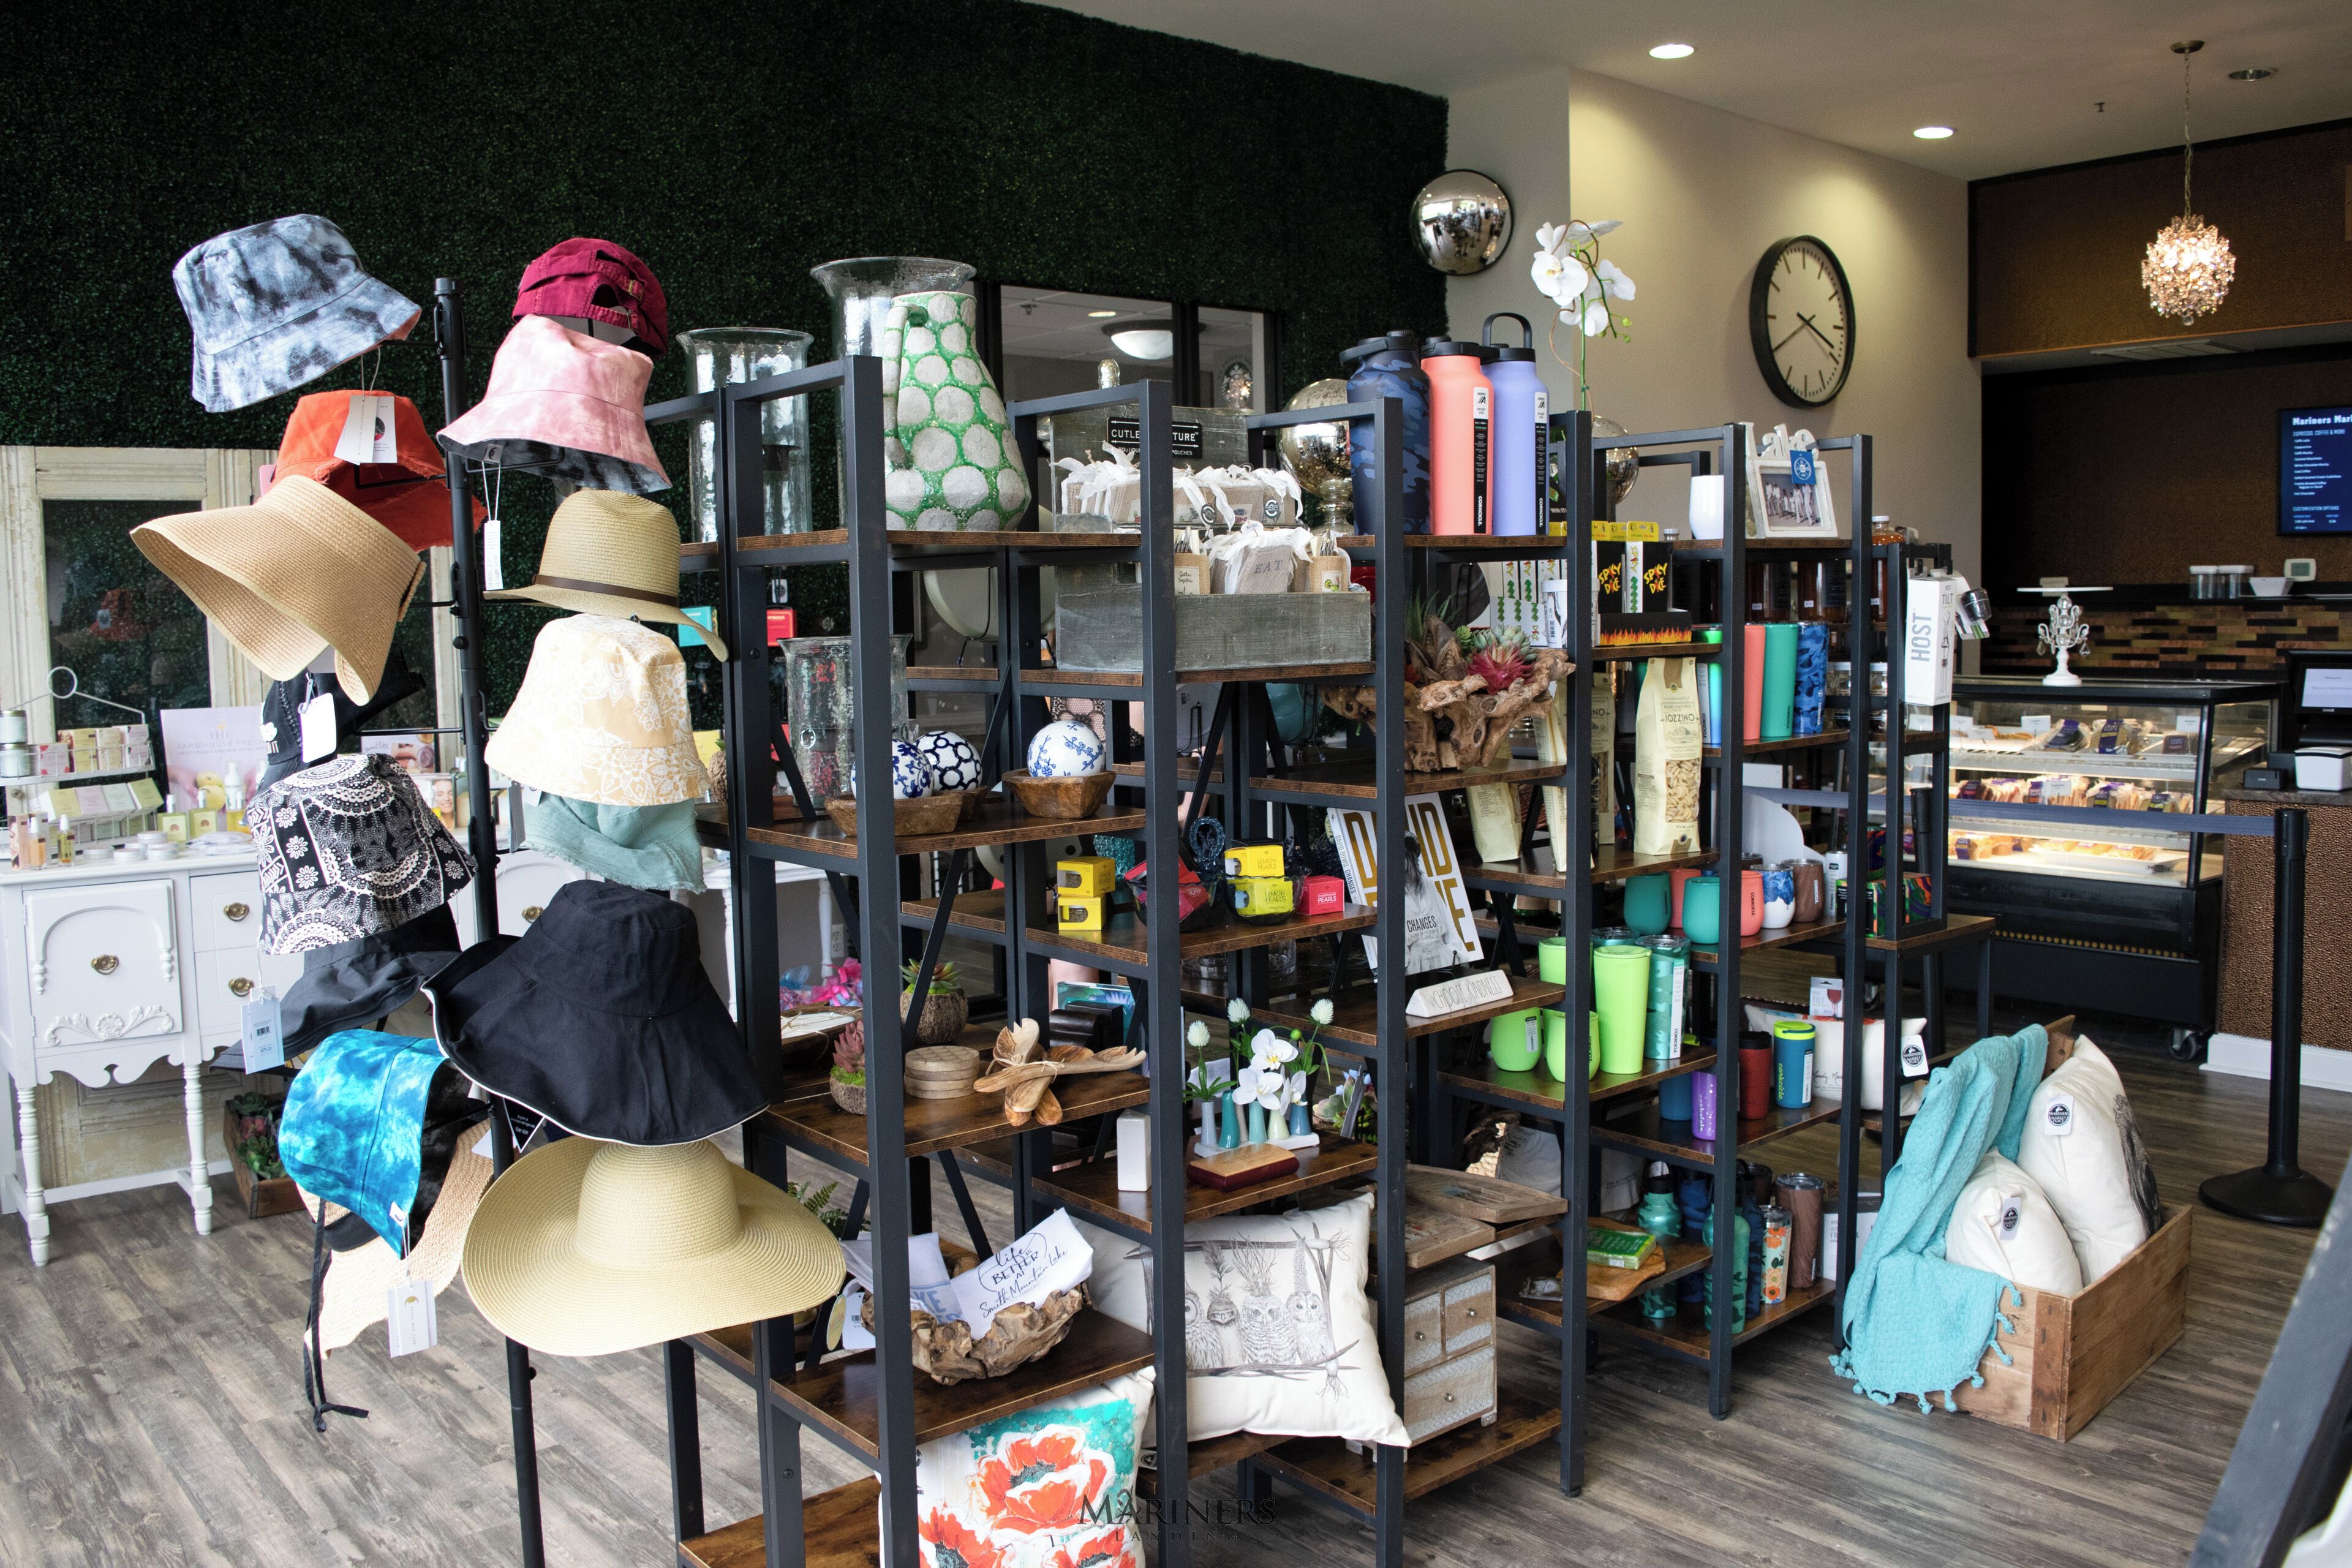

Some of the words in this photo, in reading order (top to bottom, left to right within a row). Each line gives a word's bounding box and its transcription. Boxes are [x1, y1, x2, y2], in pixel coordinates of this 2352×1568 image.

[2293, 417, 2331, 426] Mariners
[1253, 560, 1284, 575] EAT
[1942, 593, 1953, 606] TILT
[1910, 612, 1932, 662] HOST
[1665, 714, 1695, 722] IOZZINO
[177, 741, 232, 750] FARMHOUSE
[1335, 834, 1344, 851] DAVID
[1344, 869, 1357, 894] CHANGES
[1406, 915, 1437, 932] CHANGES
[1432, 984, 1469, 1009] CHOOSE
[1465, 976, 1502, 1001] KINDNESS
[992, 1251, 1039, 1285] BETTER
[1016, 1270, 1025, 1279] AT
[980, 1287, 1011, 1318] Smith
[1009, 1265, 1049, 1298] Mountain
[1049, 1246, 1068, 1266] Lake
